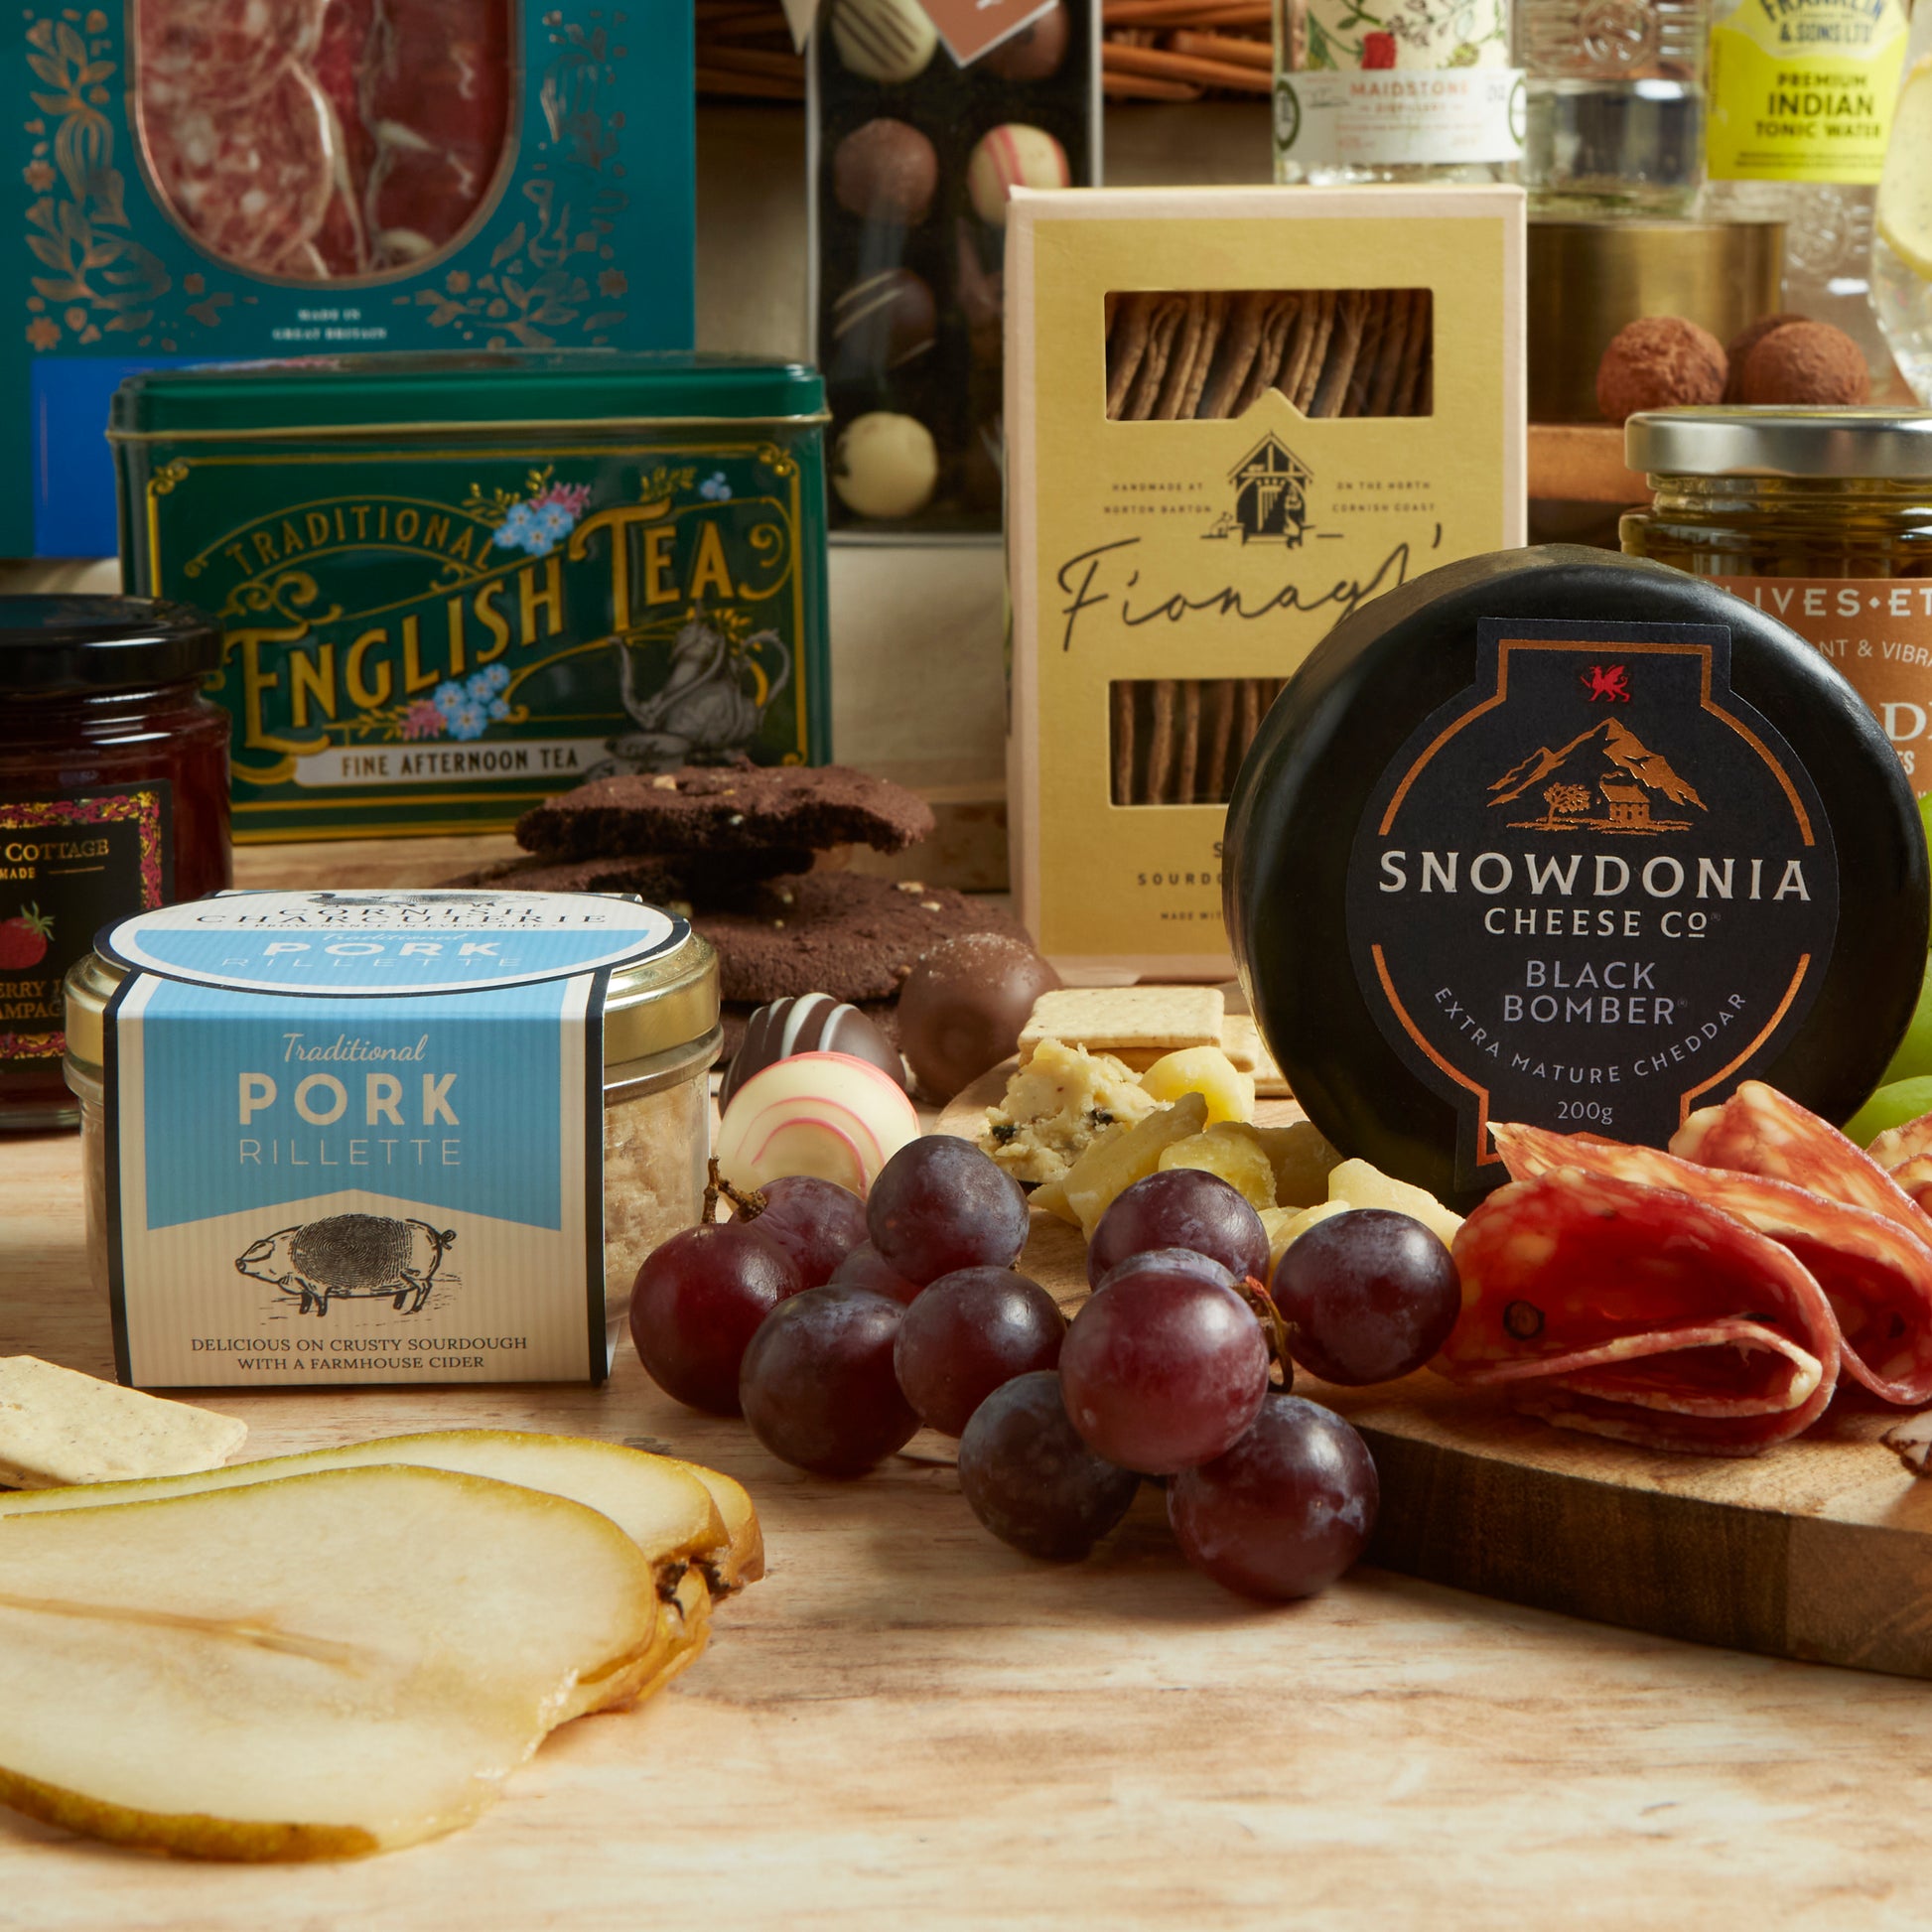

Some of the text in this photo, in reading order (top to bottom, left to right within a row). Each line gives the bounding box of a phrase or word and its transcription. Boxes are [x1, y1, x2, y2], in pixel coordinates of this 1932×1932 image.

[1350, 80, 1469, 97] MAIDSTONE
[1777, 72, 1867, 87] PREMIUM
[1767, 92, 1873, 116] INDIAN
[1755, 121, 1881, 139] TONIC WATER
[1112, 482, 1181, 491] HANDMADE
[1359, 481, 1381, 490] THE
[1332, 502, 1389, 513] CORNISH
[225, 505, 494, 576] TRADITIONAL
[224, 498, 736, 754] ENGLISH TEA
[1858, 638, 1872, 657] &
[342, 748, 579, 777] FINE AFTERNOON TEA
[5, 838, 109, 862] COTTAGE
[1378, 850, 1811, 901] SNOWDONIA
[196, 914, 609, 924] CHARCUTERIE
[278, 907, 535, 916] CORNISH
[1161, 911, 1193, 920] MADE
[1483, 907, 1641, 937] CHEESE
[262, 942, 501, 956] PORK
[221, 957, 524, 967] RILLETTE
[1526, 960, 1656, 990] BLACK
[1435, 987, 1746, 1084] EXTRA MATURE CHEDDAR
[282, 1033, 429, 1062] Traditional
[238, 1072, 460, 1126] PORK
[1557, 1101, 1613, 1125] 200g
[239, 1139, 462, 1166] RILLETTE
[191, 1337, 527, 1352] DELICIOUS ON CRUSTY SOURDOUGH
[237, 1356, 484, 1370] WITH A FARMHOUSE CIDER
